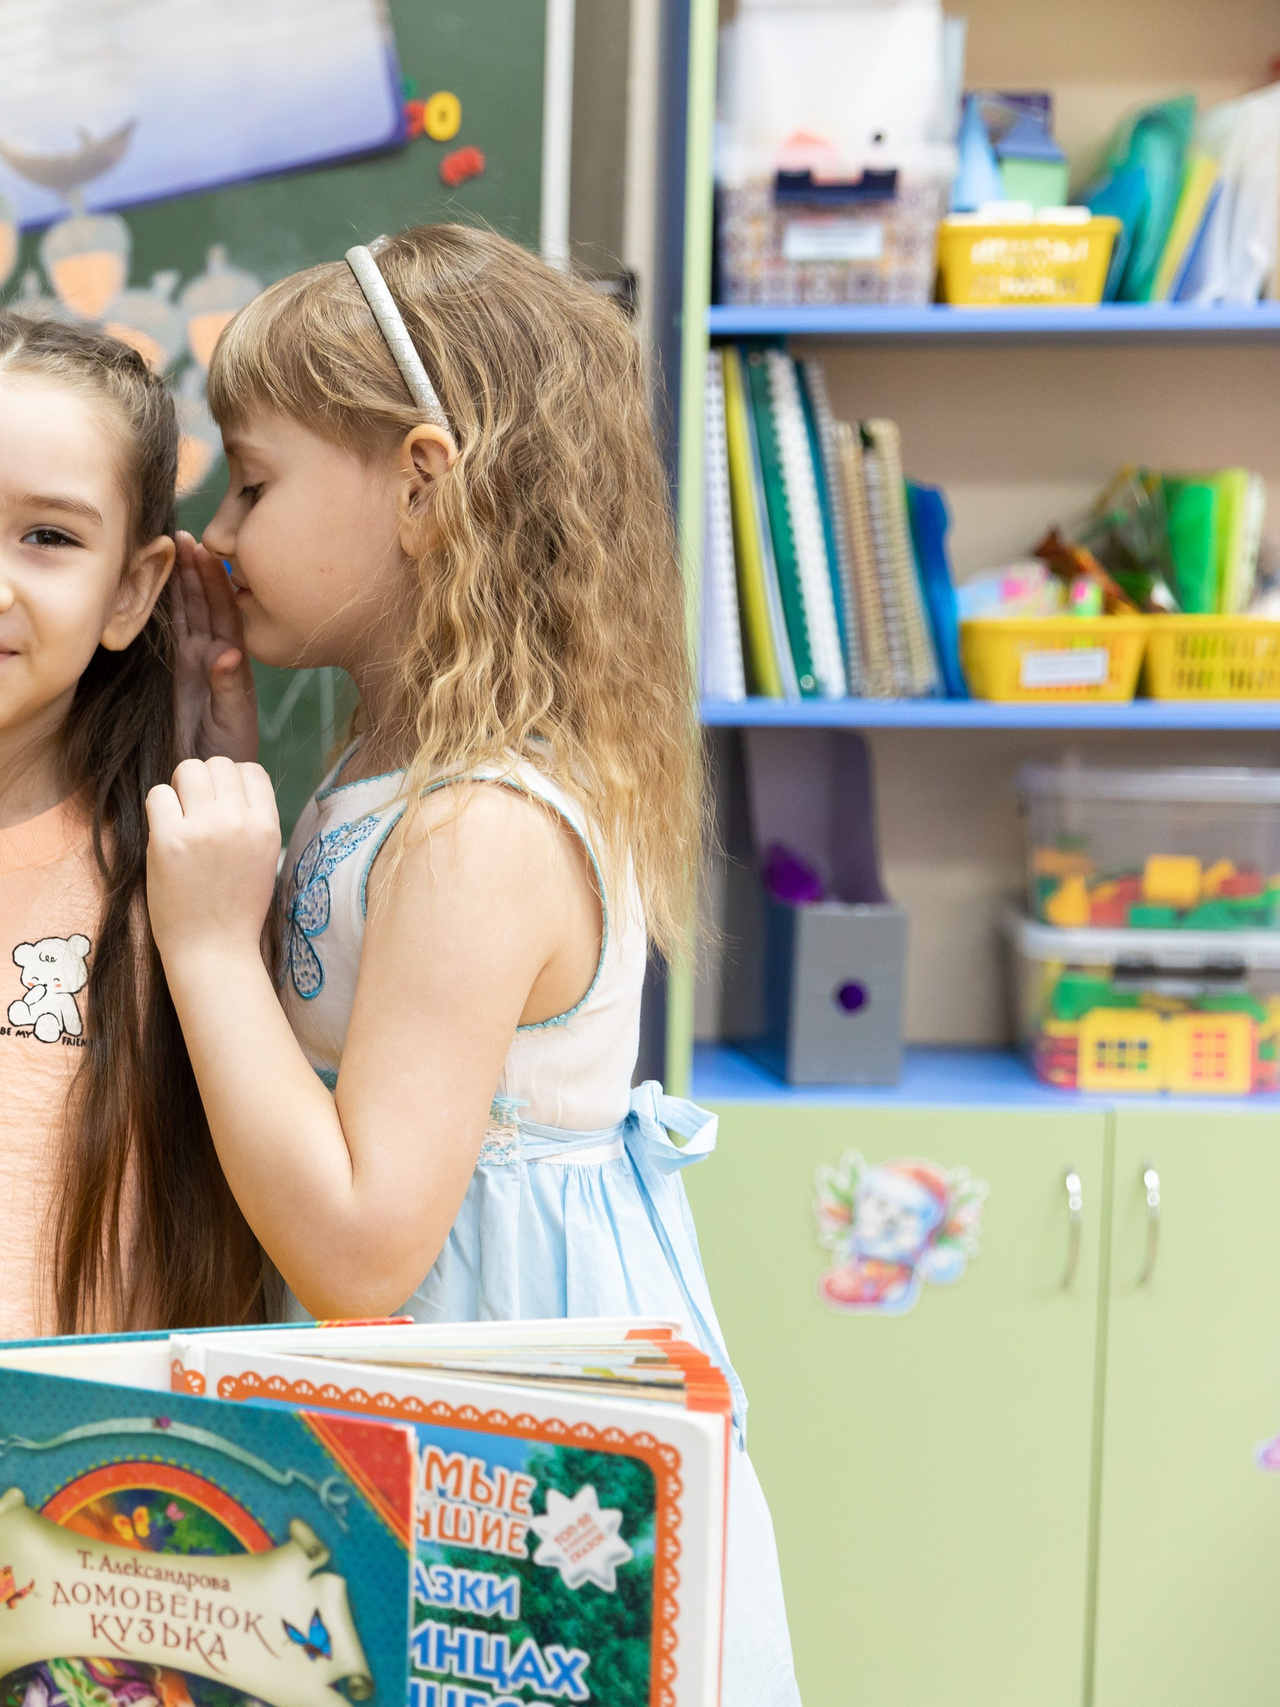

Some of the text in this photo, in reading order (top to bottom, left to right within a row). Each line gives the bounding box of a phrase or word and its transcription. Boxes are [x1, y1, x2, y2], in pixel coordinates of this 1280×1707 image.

[0, 1026, 88, 1047] BE MY FRIEN
[423, 1450, 532, 1516] МЫЕ
[77, 1549, 231, 1593] Т. Александрова
[89, 1612, 228, 1677] КУЗЬКА
